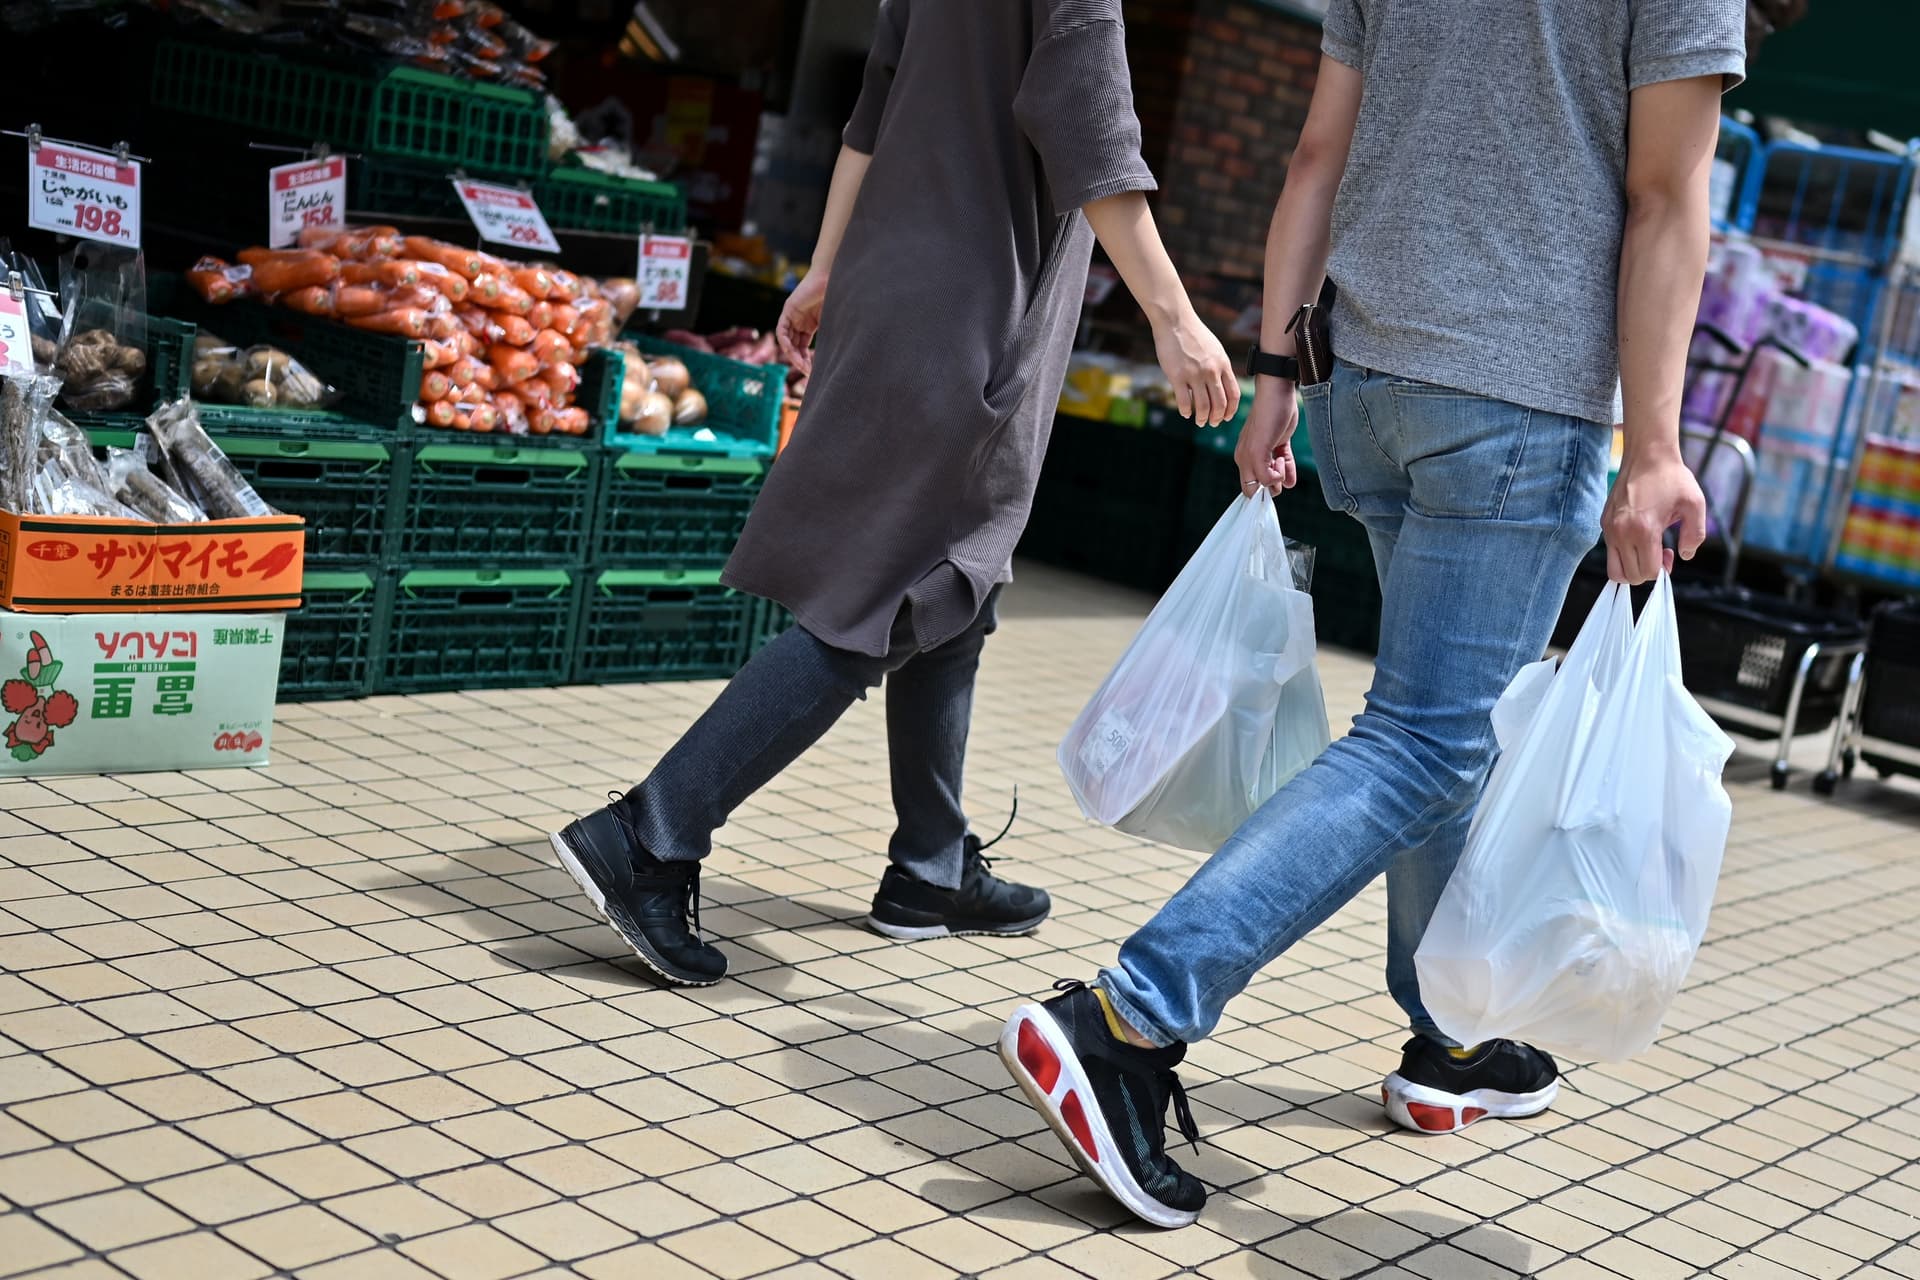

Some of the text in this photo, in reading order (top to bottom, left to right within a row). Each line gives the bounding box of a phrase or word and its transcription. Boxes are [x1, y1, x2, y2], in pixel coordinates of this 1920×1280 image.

[42, 179, 128, 210] じゃがいも
[283, 190, 334, 213] にんじん
[0, 325, 15, 339] う
[36, 539, 249, 580] 千葉 サツマイモ
[110, 583, 221, 597] まるは園芸出荷組合
[95, 631, 198, 661] にんじん
[213, 627, 274, 646] 千葉県産
[91, 675, 195, 719] 富里
